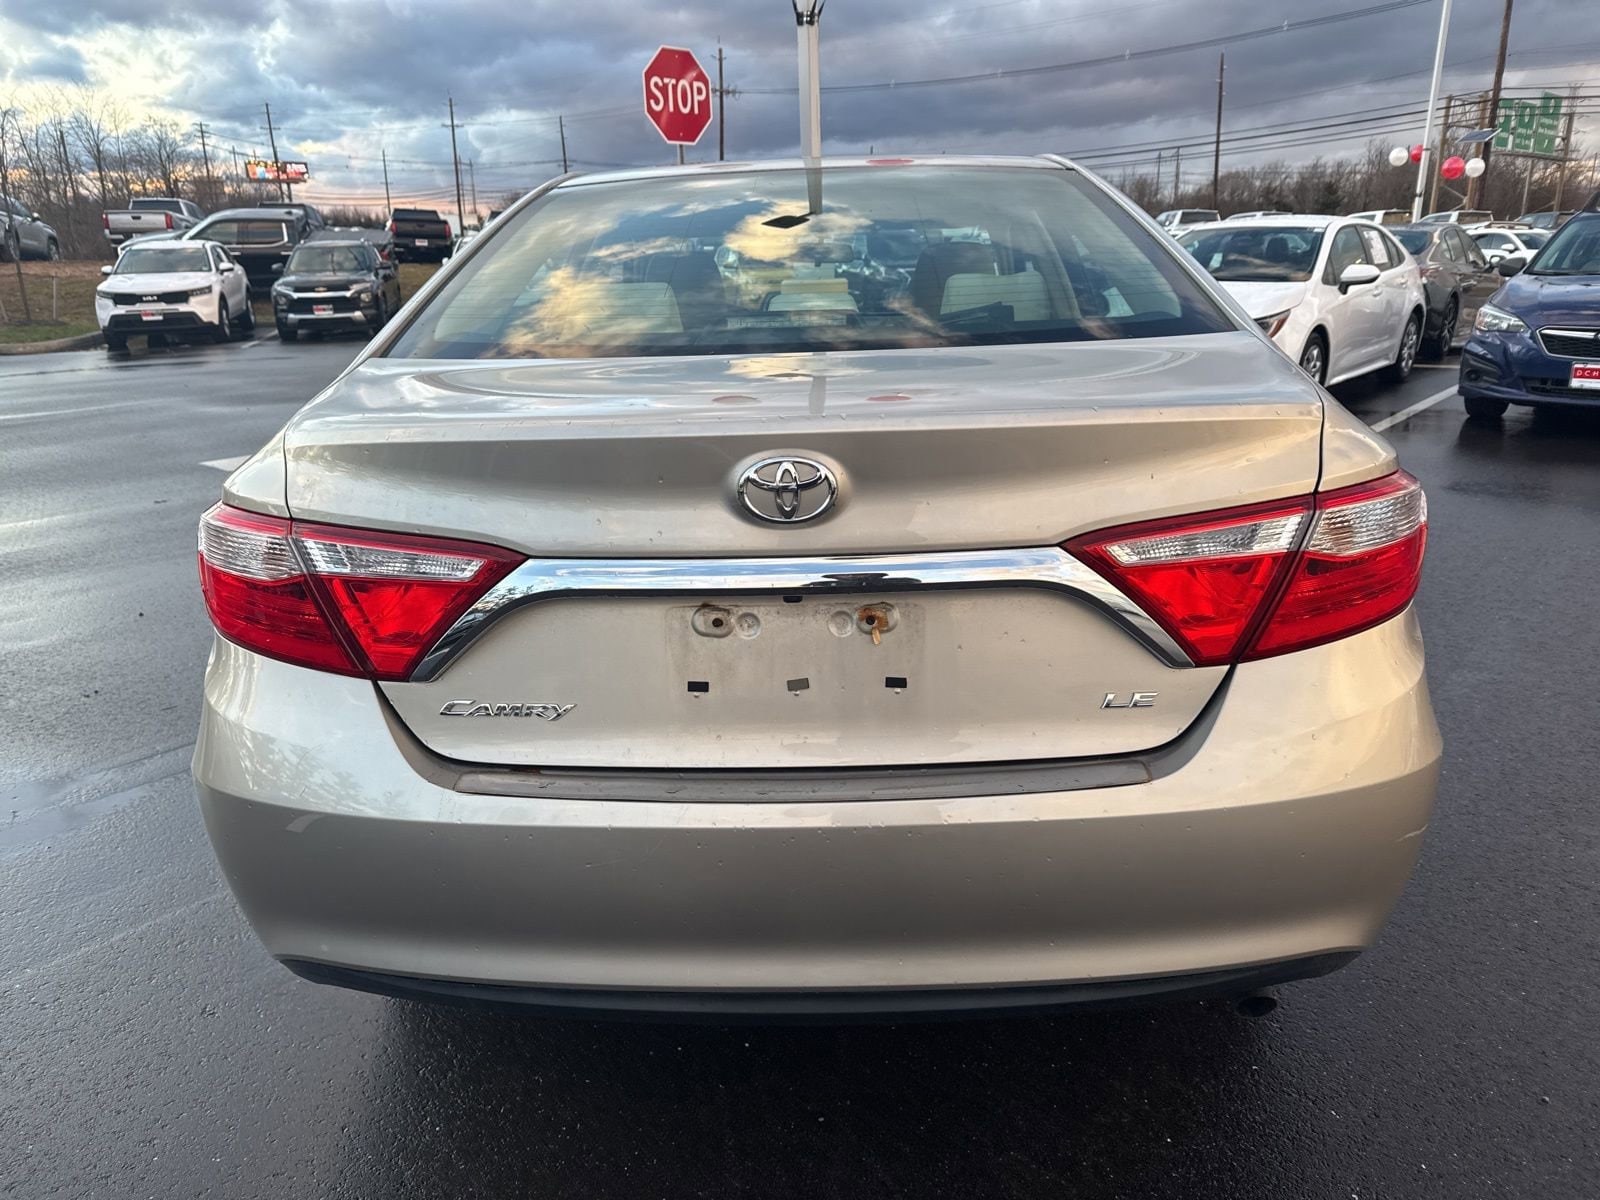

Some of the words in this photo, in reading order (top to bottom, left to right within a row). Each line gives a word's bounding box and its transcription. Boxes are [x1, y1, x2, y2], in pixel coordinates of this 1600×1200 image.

[649, 75, 707, 115] STOP
[1576, 369, 1600, 377] DCH
[1100, 691, 1160, 709] LE
